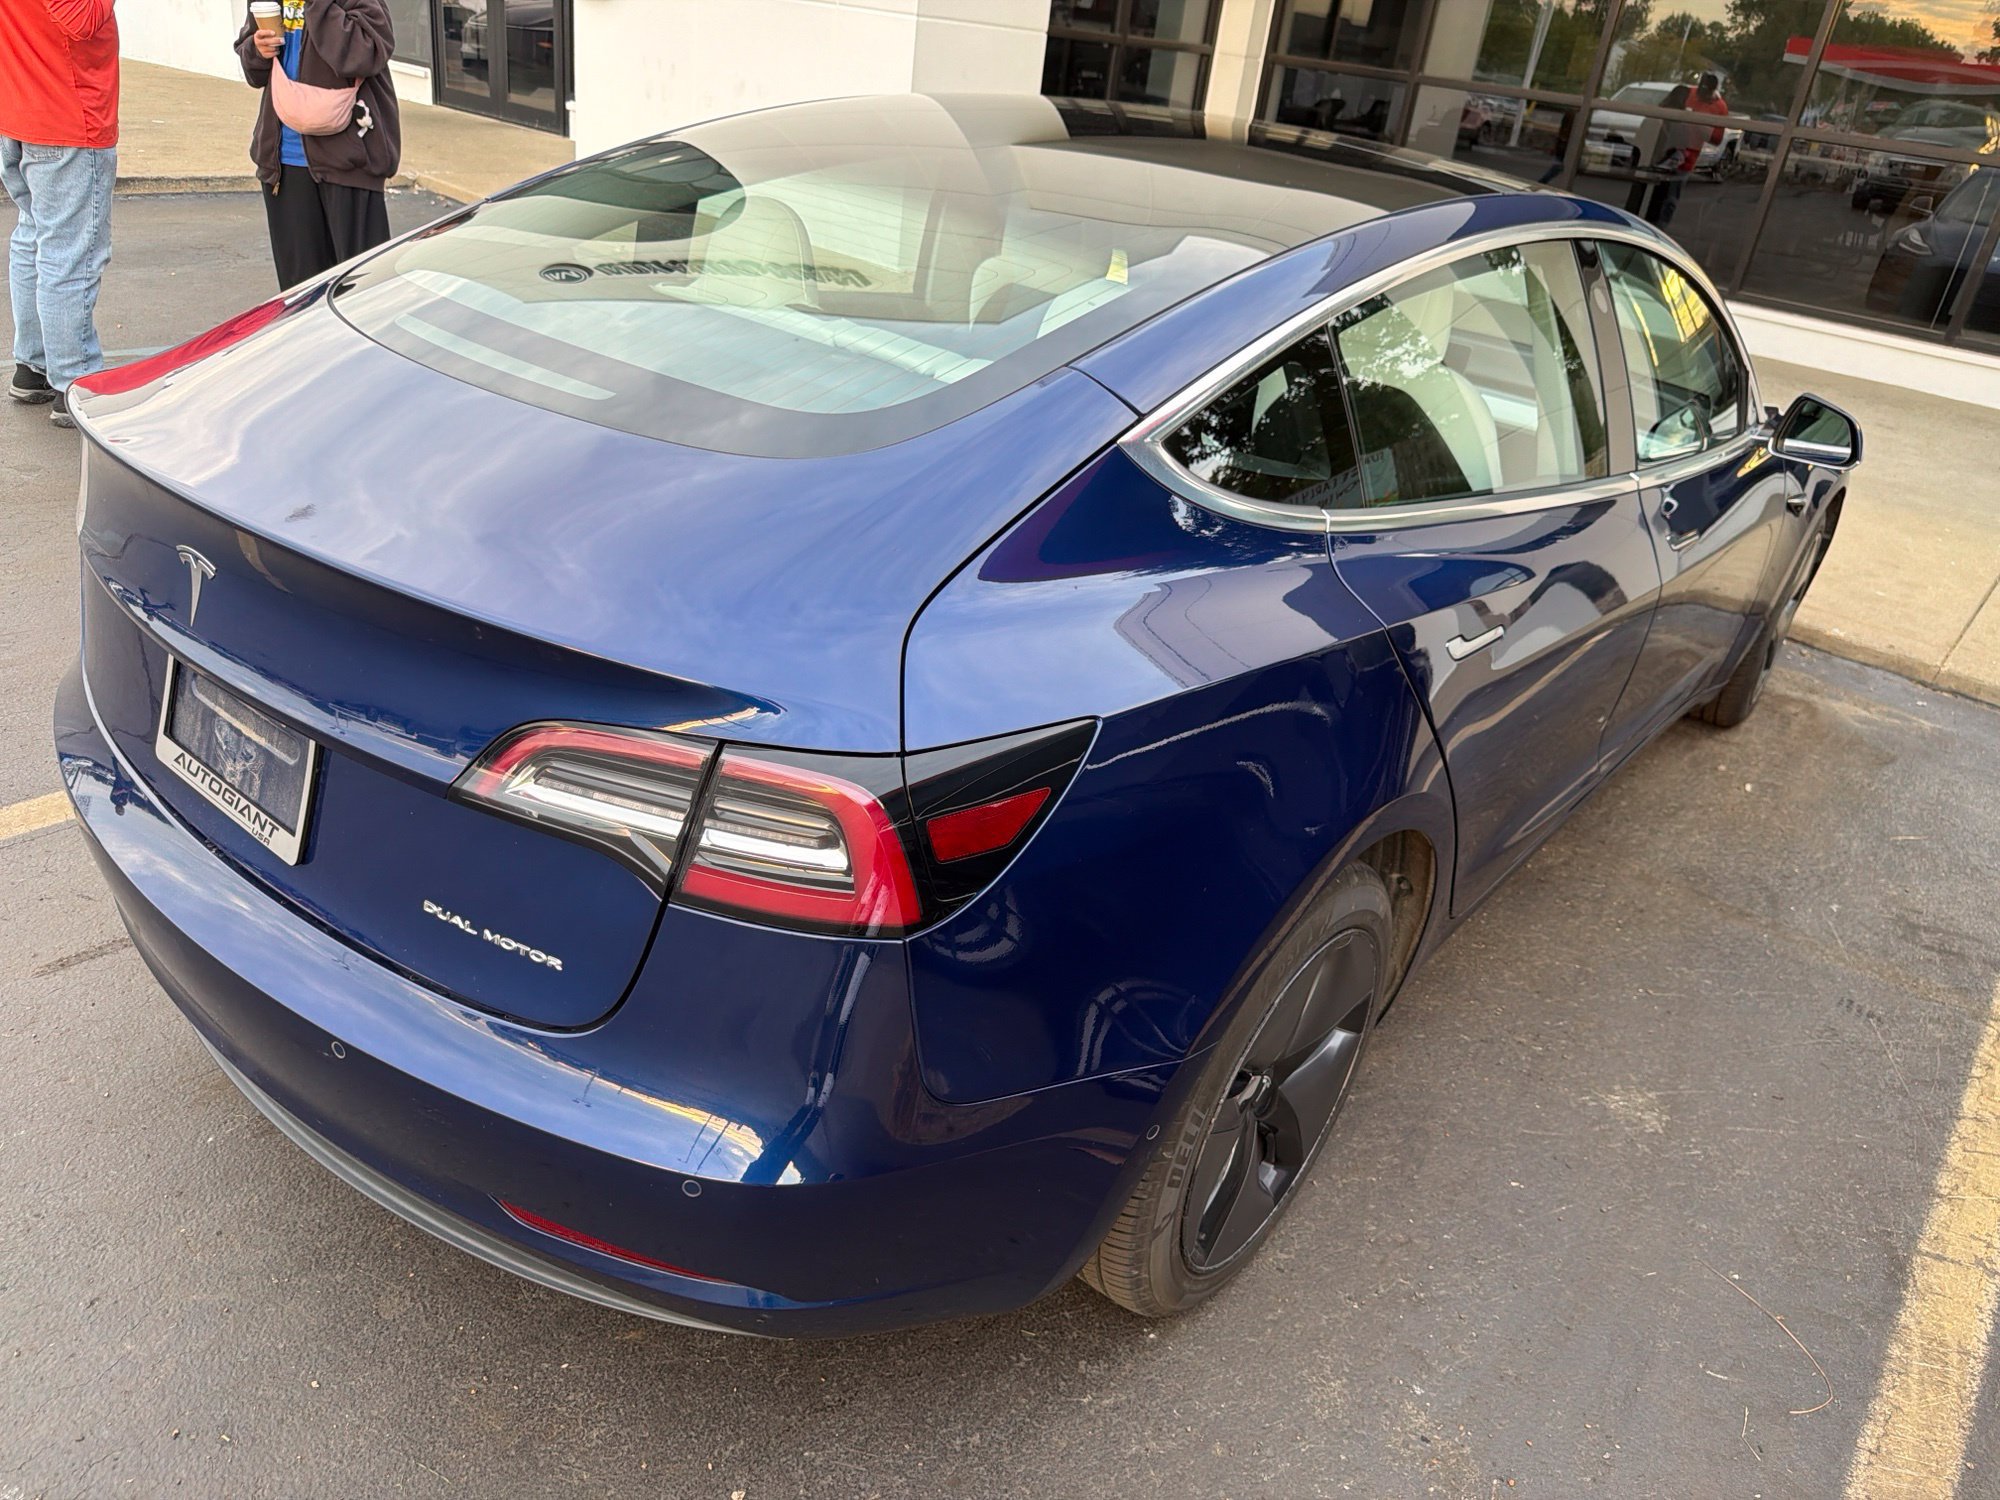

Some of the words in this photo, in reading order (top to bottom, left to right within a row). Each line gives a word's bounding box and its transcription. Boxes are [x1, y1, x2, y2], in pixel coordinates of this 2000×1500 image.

[173, 752, 280, 839] AUTOGIANT
[251, 828, 271, 846] USA
[423, 899, 478, 935] DUAL
[483, 928, 563, 971] MOTOR
